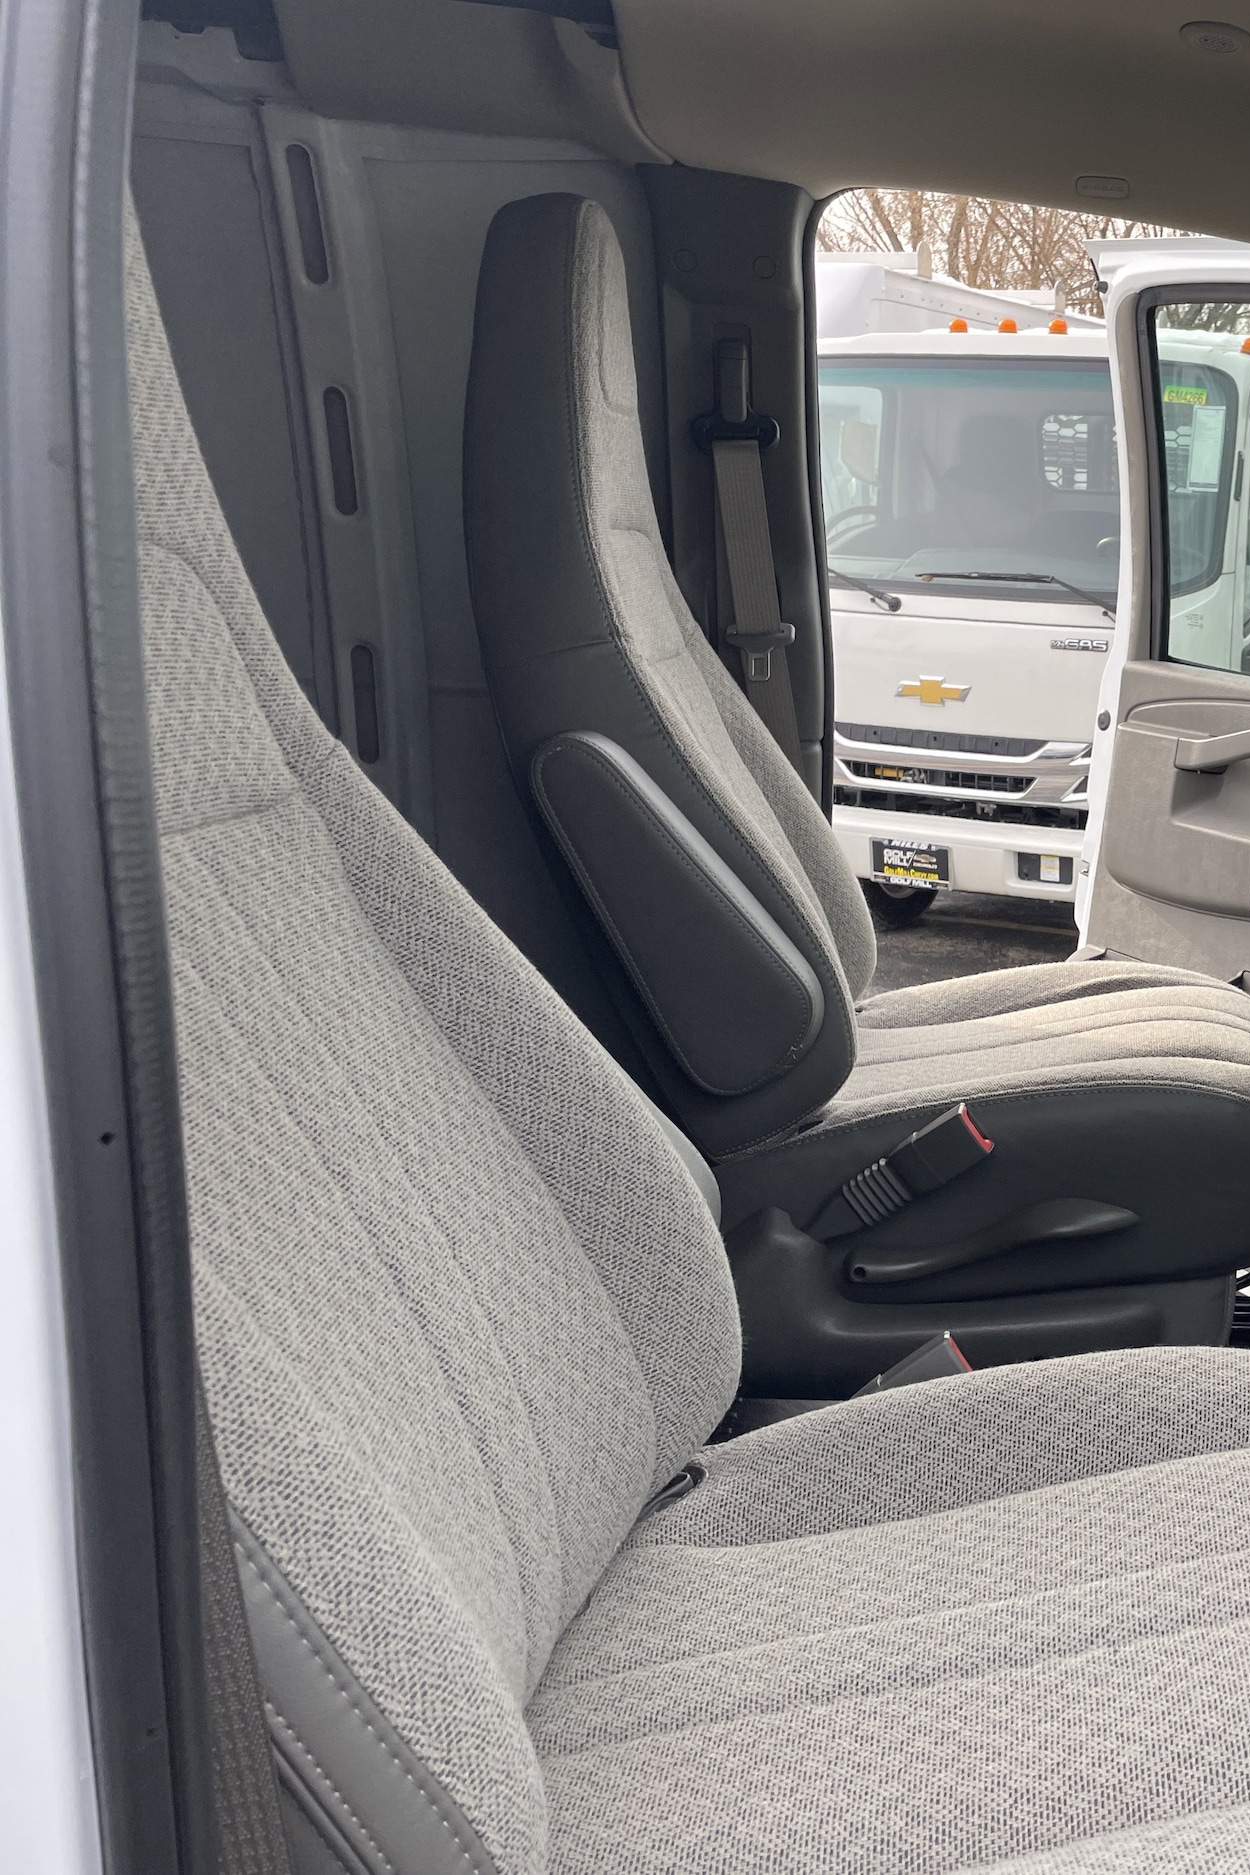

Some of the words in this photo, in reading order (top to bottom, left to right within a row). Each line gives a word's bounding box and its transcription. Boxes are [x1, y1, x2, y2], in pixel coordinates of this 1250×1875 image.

[1064, 638, 1108, 652] GAS
[883, 848, 913, 860] GOLF
[884, 856, 908, 867] MILL
[911, 879, 932, 888] MILL
